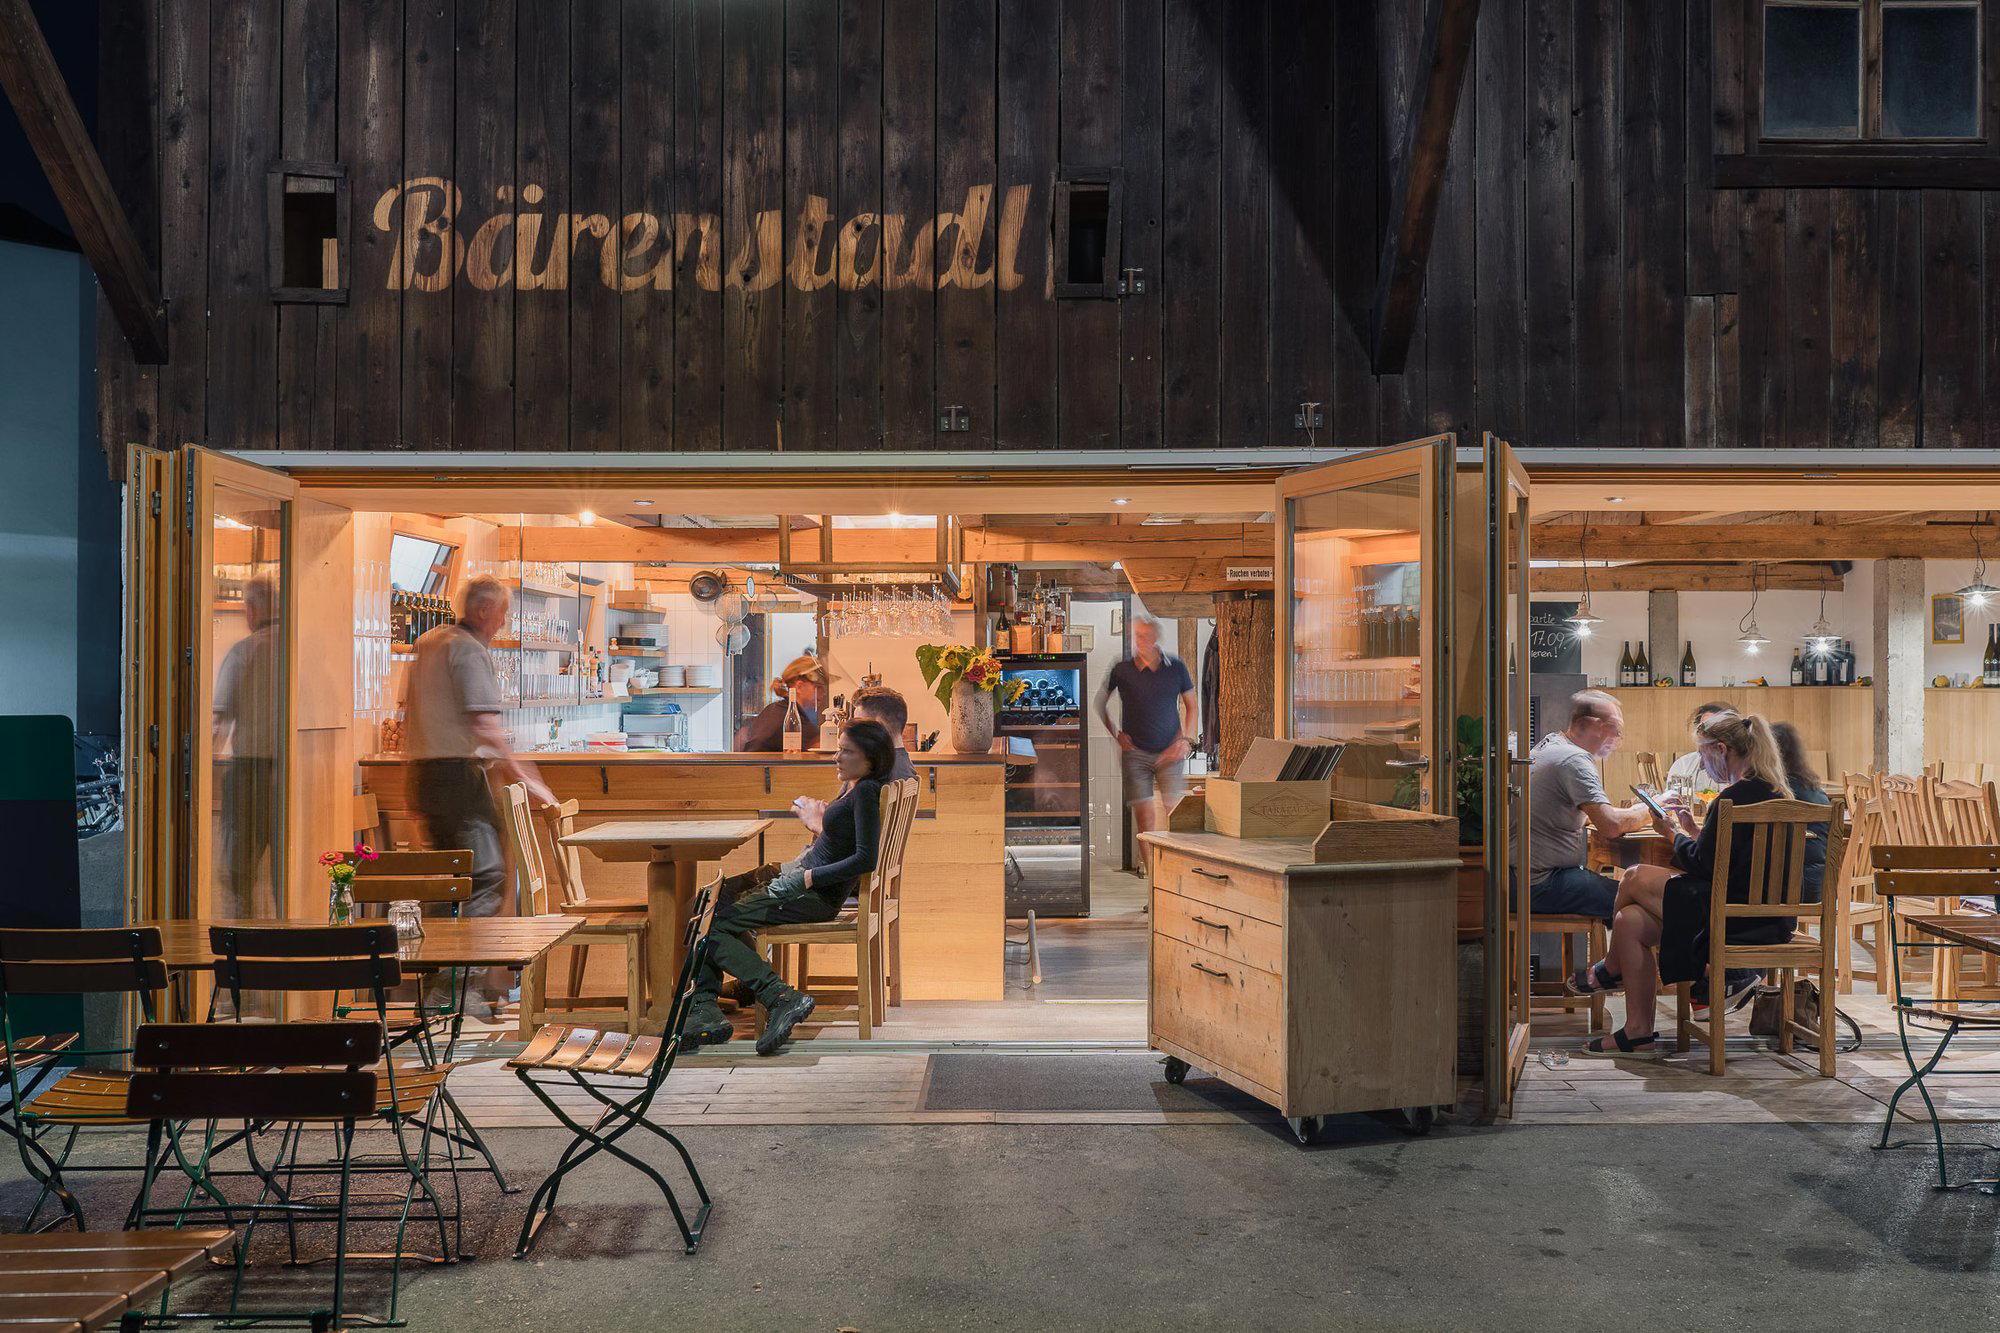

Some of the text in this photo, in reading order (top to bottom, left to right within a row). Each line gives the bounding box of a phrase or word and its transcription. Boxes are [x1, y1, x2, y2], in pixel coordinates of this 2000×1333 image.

[373, 177, 1032, 292] Bärenstadl
[1229, 569, 1270, 578] Rauchen verboten
[1531, 630, 1567, 650] 17.09.
